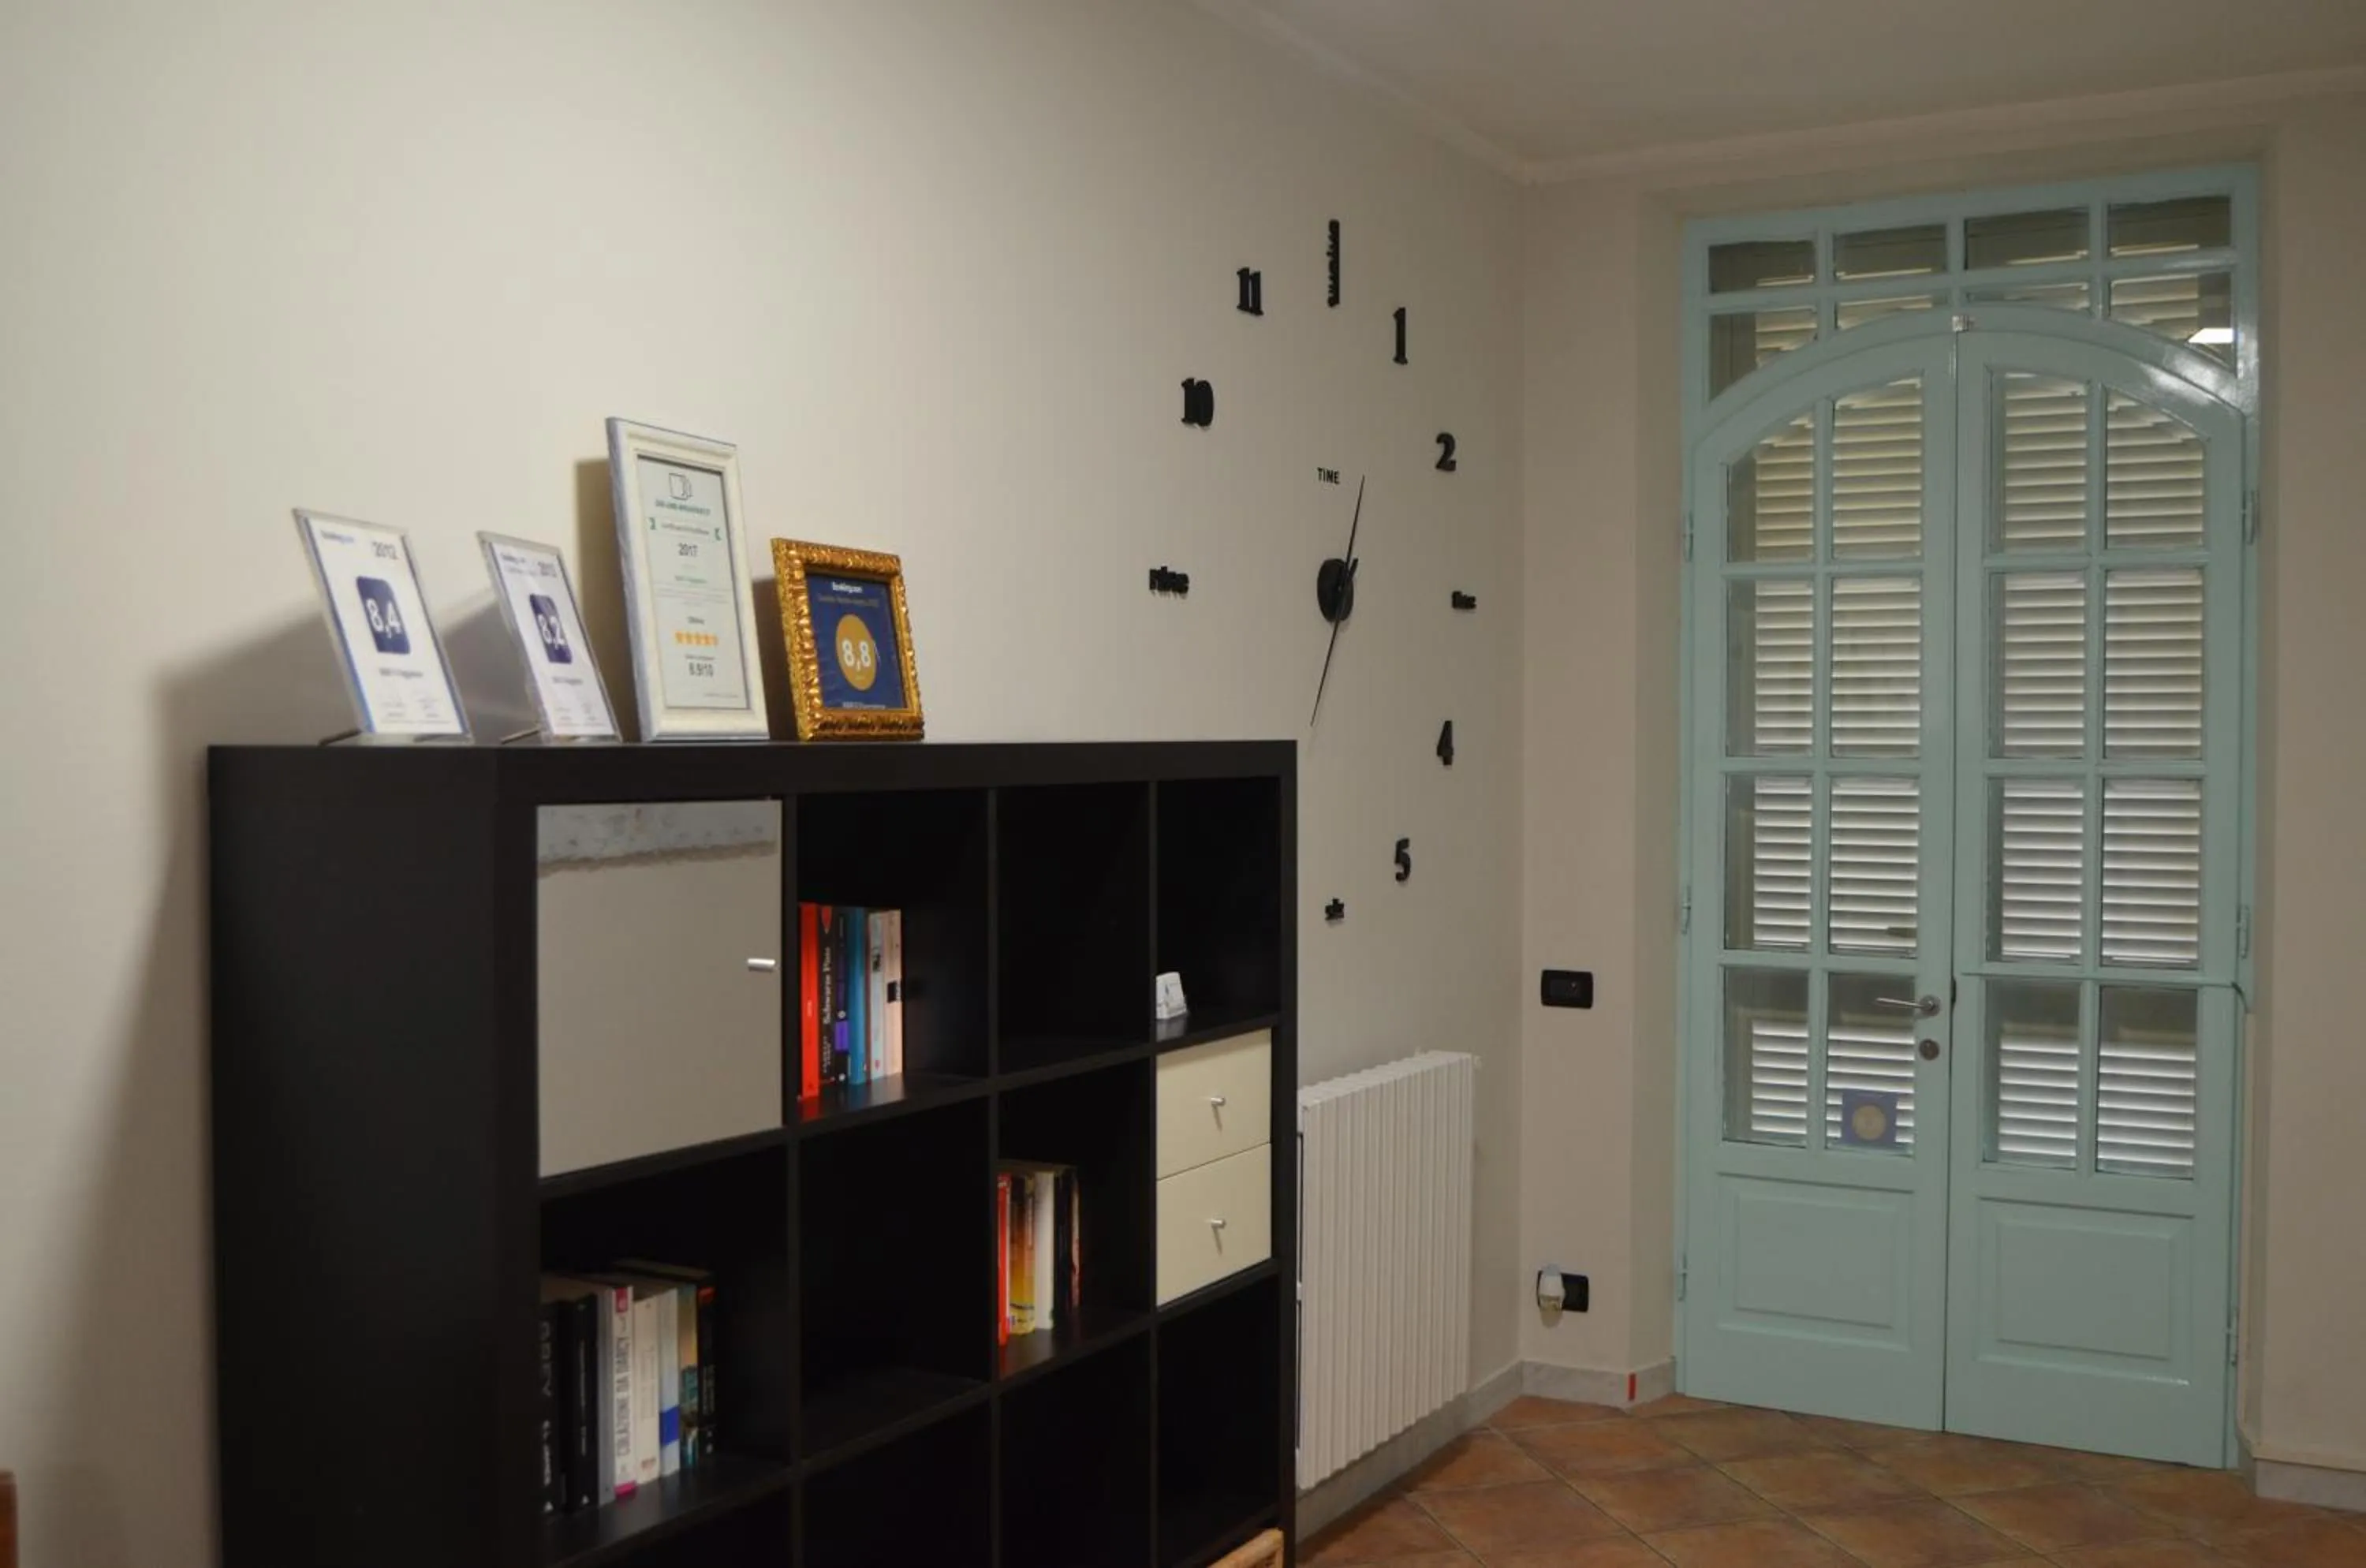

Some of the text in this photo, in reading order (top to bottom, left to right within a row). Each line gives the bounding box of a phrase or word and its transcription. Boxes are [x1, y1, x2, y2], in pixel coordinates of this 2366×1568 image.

[1236, 267, 1263, 316] 11
[1393, 307, 1409, 365] 1
[1181, 378, 1215, 427] 10
[1435, 432, 1457, 472] 2
[1317, 467, 1340, 484] TIME
[367, 599, 401, 638] 8,4
[842, 638, 871, 670] 8,8
[1436, 720, 1454, 766] 4
[1394, 838, 1411, 883] 5
